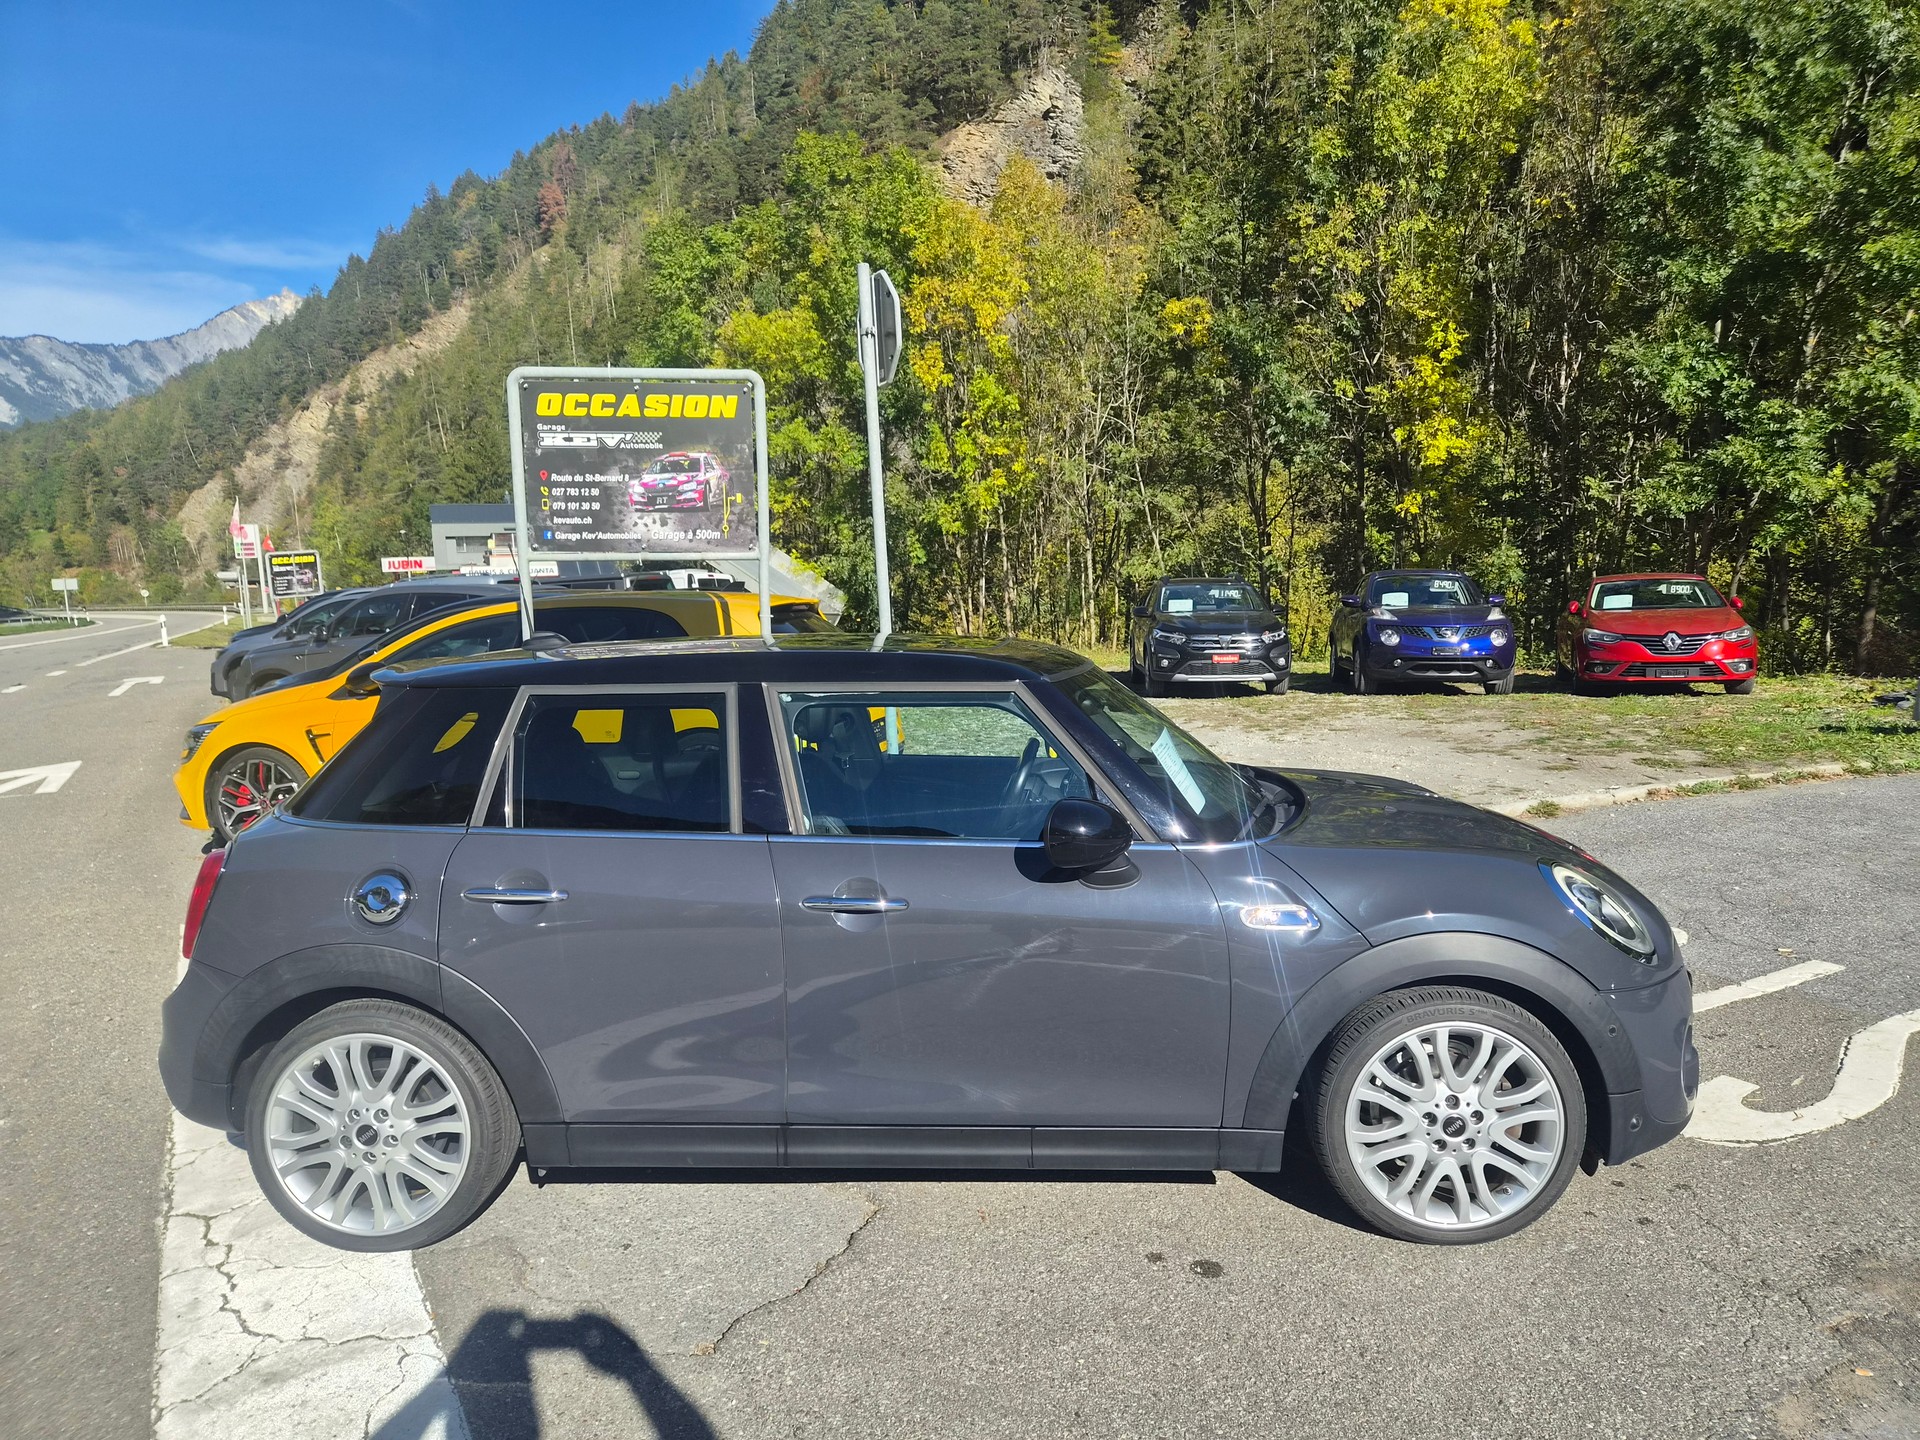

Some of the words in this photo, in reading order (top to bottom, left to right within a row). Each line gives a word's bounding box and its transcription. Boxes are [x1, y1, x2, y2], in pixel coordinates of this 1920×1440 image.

[536, 393, 738, 418] OCCASION
[537, 423, 566, 432] Garage
[619, 442, 663, 450] Automobile
[551, 473, 573, 482] Route
[574, 473, 583, 482] du
[585, 473, 623, 482] St-Bernard
[551, 488, 565, 496] 027
[566, 488, 579, 496] 783
[581, 488, 589, 496] 12
[590, 488, 600, 496] 50
[552, 502, 566, 510] 079
[567, 502, 580, 510] 101
[581, 502, 589, 510] 30
[591, 502, 600, 510] 50
[553, 516, 592, 524] kevauto.ch
[555, 532, 581, 541] Garage
[582, 531, 642, 540] Kev'Automobiles
[651, 530, 685, 541] Garage
[687, 529, 693, 539] à
[695, 530, 721, 540] 500m
[387, 560, 423, 570] JUBIN
[1406, 1007, 1465, 1023] BRAVURIS
[1445, 1119, 1464, 1134] MINI
[358, 1128, 375, 1143] MINI
